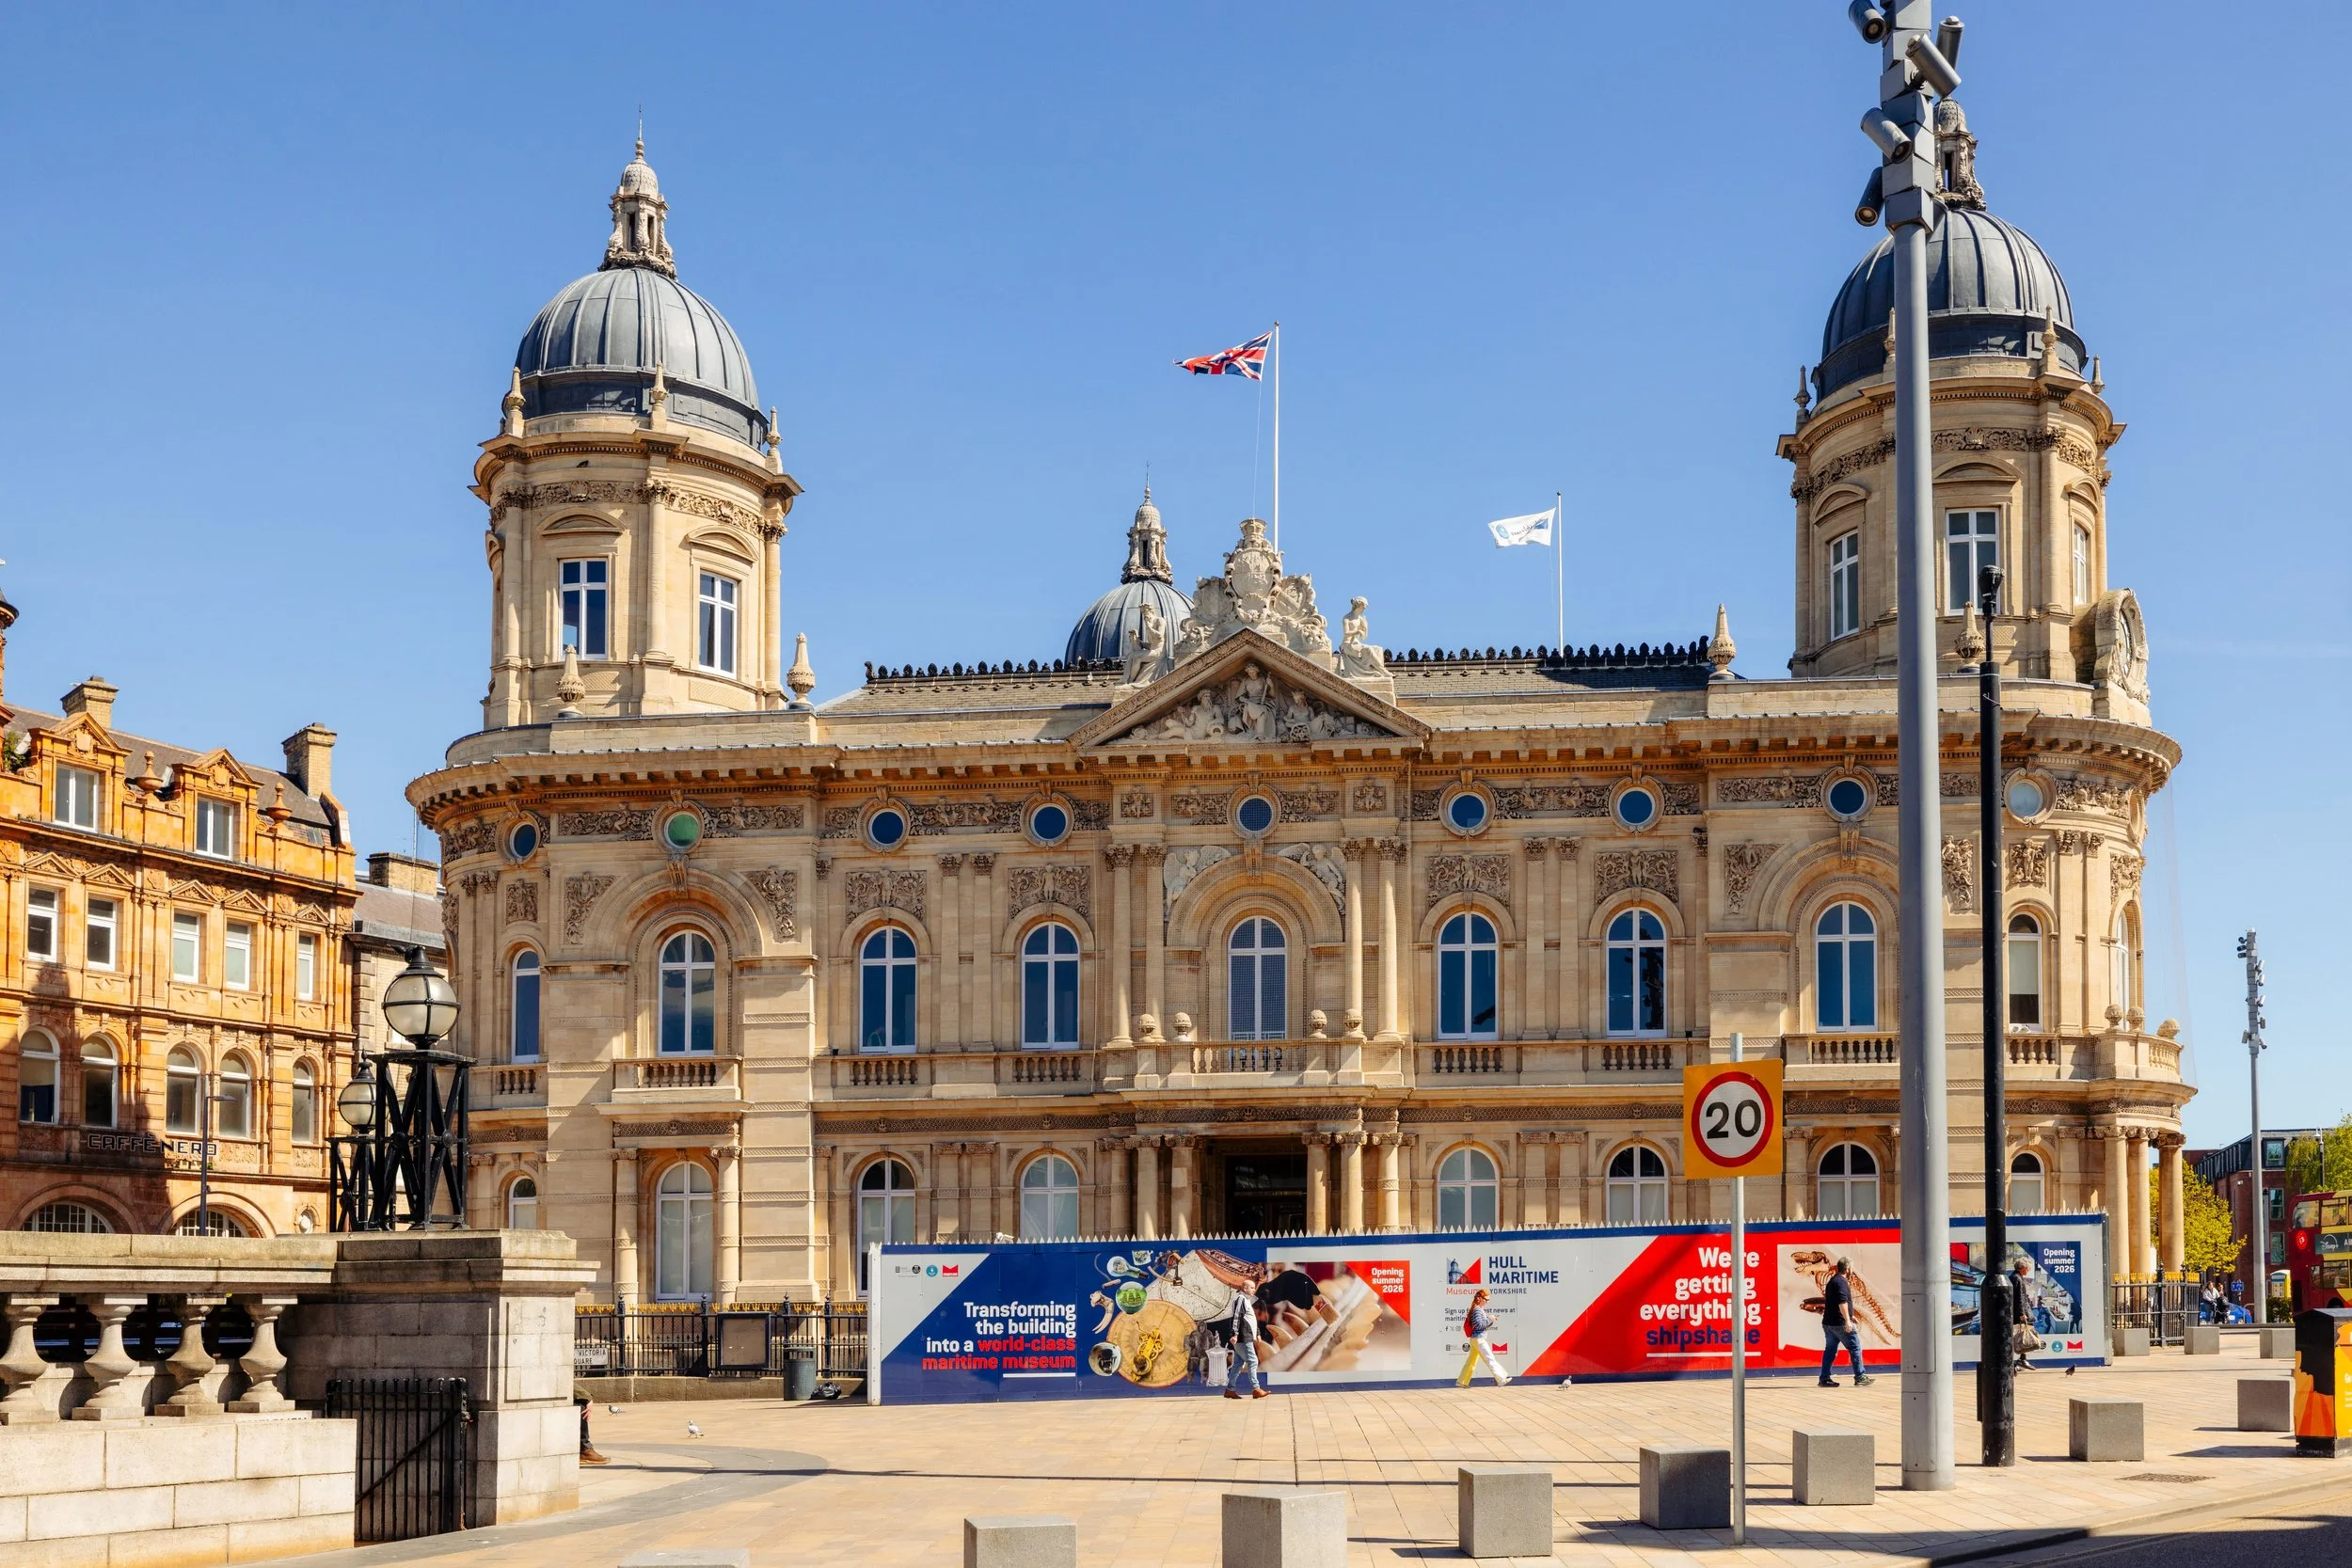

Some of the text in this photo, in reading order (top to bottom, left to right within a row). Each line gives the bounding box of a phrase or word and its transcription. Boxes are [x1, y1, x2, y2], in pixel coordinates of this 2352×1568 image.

[1706, 1100, 1761, 1139] 20
[87, 1132, 217, 1156] CAFFÈ NERO
[2043, 1248, 2075, 1259] Opening
[1488, 1256, 1527, 1269] HULL
[1372, 1267, 1404, 1277] Opening
[1488, 1271, 1559, 1284] MARITIME
[1382, 1285, 1404, 1293] 2026
[963, 1301, 1076, 1321] Transforming
[1640, 1298, 1761, 1325] everythig
[975, 1319, 1076, 1338] the building
[927, 1336, 1076, 1353] into a world-class
[1646, 1324, 1760, 1352] shipshae
[922, 1354, 1075, 1370] maritime museum
